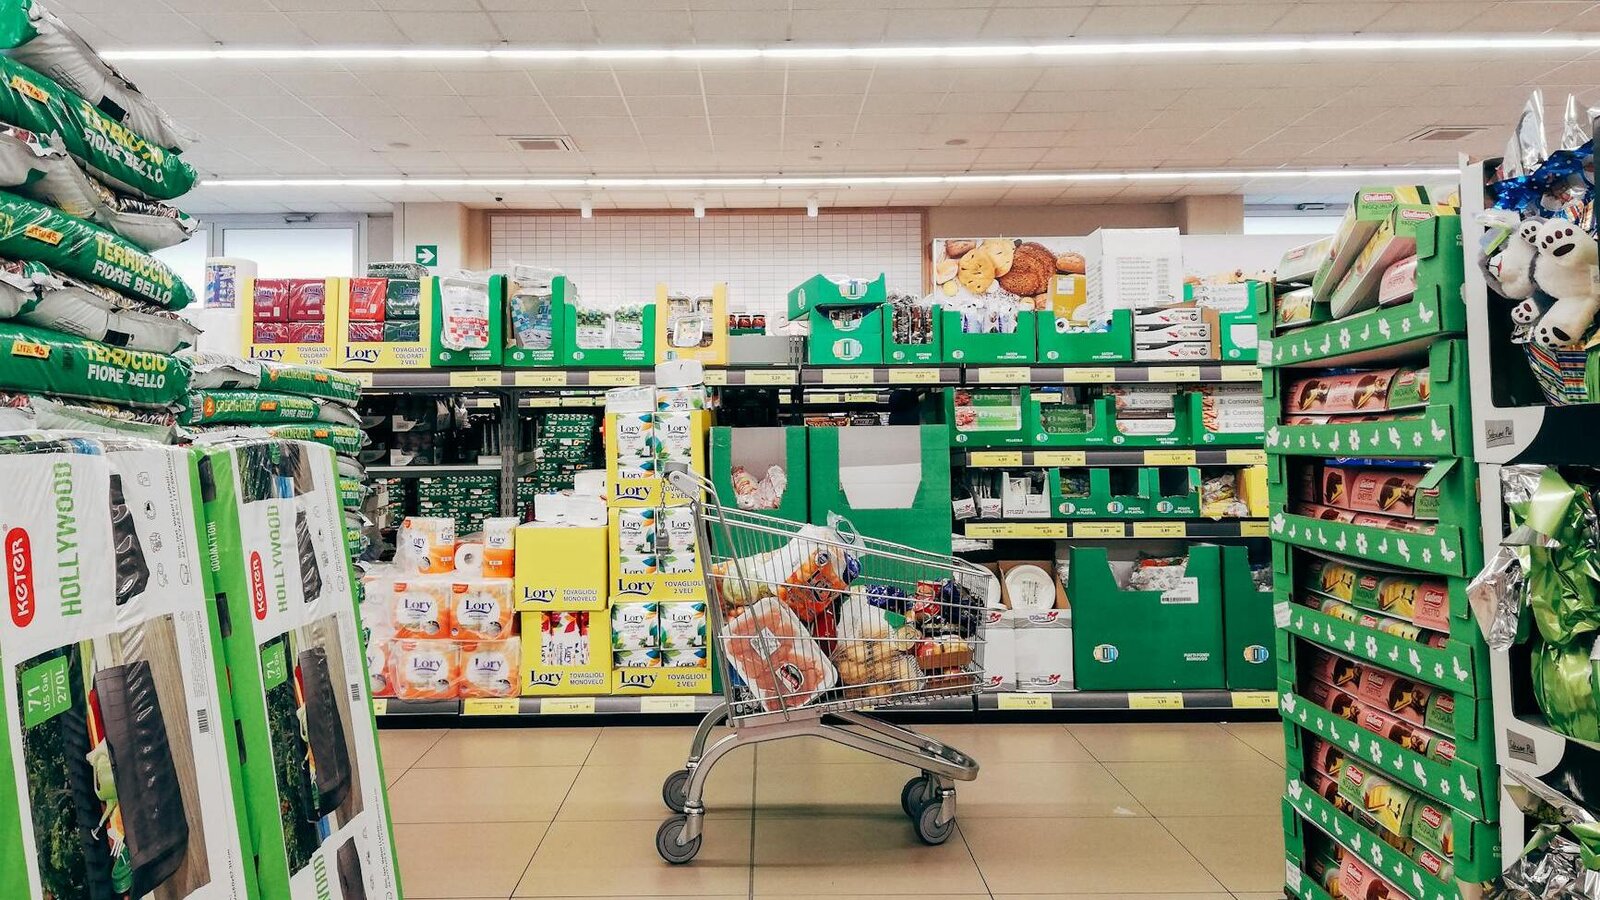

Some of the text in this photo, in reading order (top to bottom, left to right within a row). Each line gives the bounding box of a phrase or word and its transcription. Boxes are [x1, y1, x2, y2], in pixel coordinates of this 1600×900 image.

[83, 127, 164, 183] FIORE BELLO
[92, 259, 132, 287] FIORE
[133, 275, 172, 305] BELLO
[82, 340, 168, 373] TERRICCIO
[250, 346, 285, 362] Lory
[345, 346, 381, 362] Lory
[87, 363, 166, 389] FIORE BELLO
[206, 401, 213, 412] 2
[620, 424, 641, 434] Lory
[667, 424, 689, 433] Lory
[615, 483, 653, 499] Lory
[622, 519, 642, 530] Lory
[671, 520, 691, 530] Lory
[53, 462, 82, 617] HOLLYWOOD
[207, 521, 220, 572] HOLLYWOOD
[489, 535, 506, 545] Lory
[267, 505, 288, 613] HOLLYWOOD
[11, 537, 29, 617] KETER
[665, 580, 704, 588] TOVAGLIOLI
[252, 559, 265, 613] KETER
[618, 578, 656, 595] Lory
[524, 586, 557, 603] Lory
[404, 599, 432, 611] Lory
[465, 599, 494, 612] Lory
[624, 613, 645, 623] Lory
[672, 613, 693, 623] Lory
[266, 660, 276, 679] 71
[413, 658, 443, 670] Lory
[475, 658, 504, 670] Lory
[275, 666, 281, 679] US
[530, 669, 563, 685] Lory
[620, 670, 658, 686] Lory
[55, 664, 67, 703] 270L
[27, 685, 41, 713] 71
[41, 672, 51, 712] US Gal
